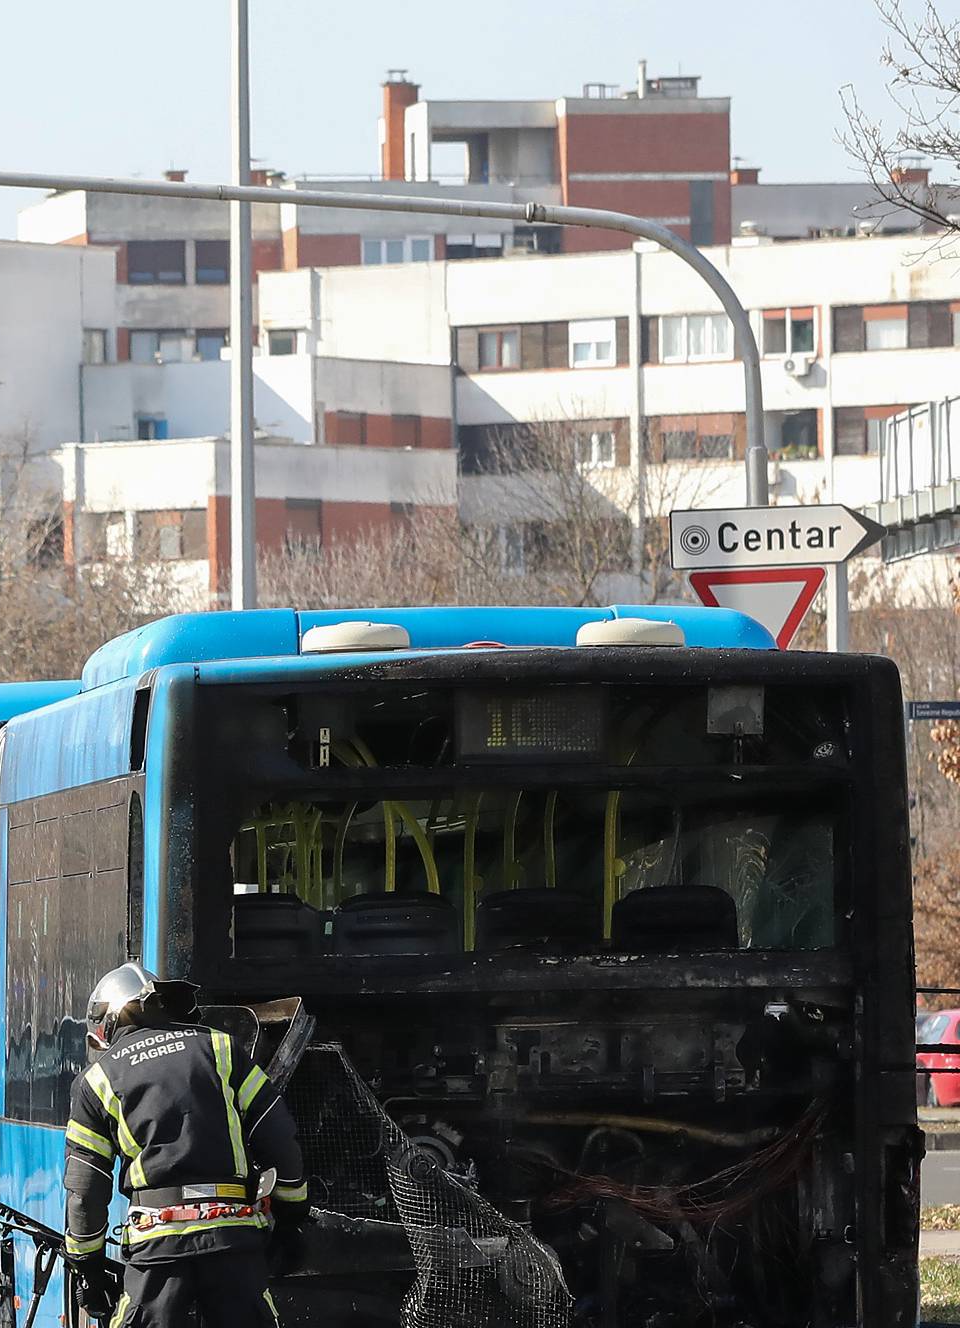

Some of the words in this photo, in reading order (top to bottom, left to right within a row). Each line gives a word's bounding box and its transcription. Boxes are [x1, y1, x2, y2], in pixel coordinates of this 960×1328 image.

[717, 519, 842, 553] Centar
[111, 1029, 198, 1060] VATROGASCI
[129, 1041, 186, 1066] ZAGREB
